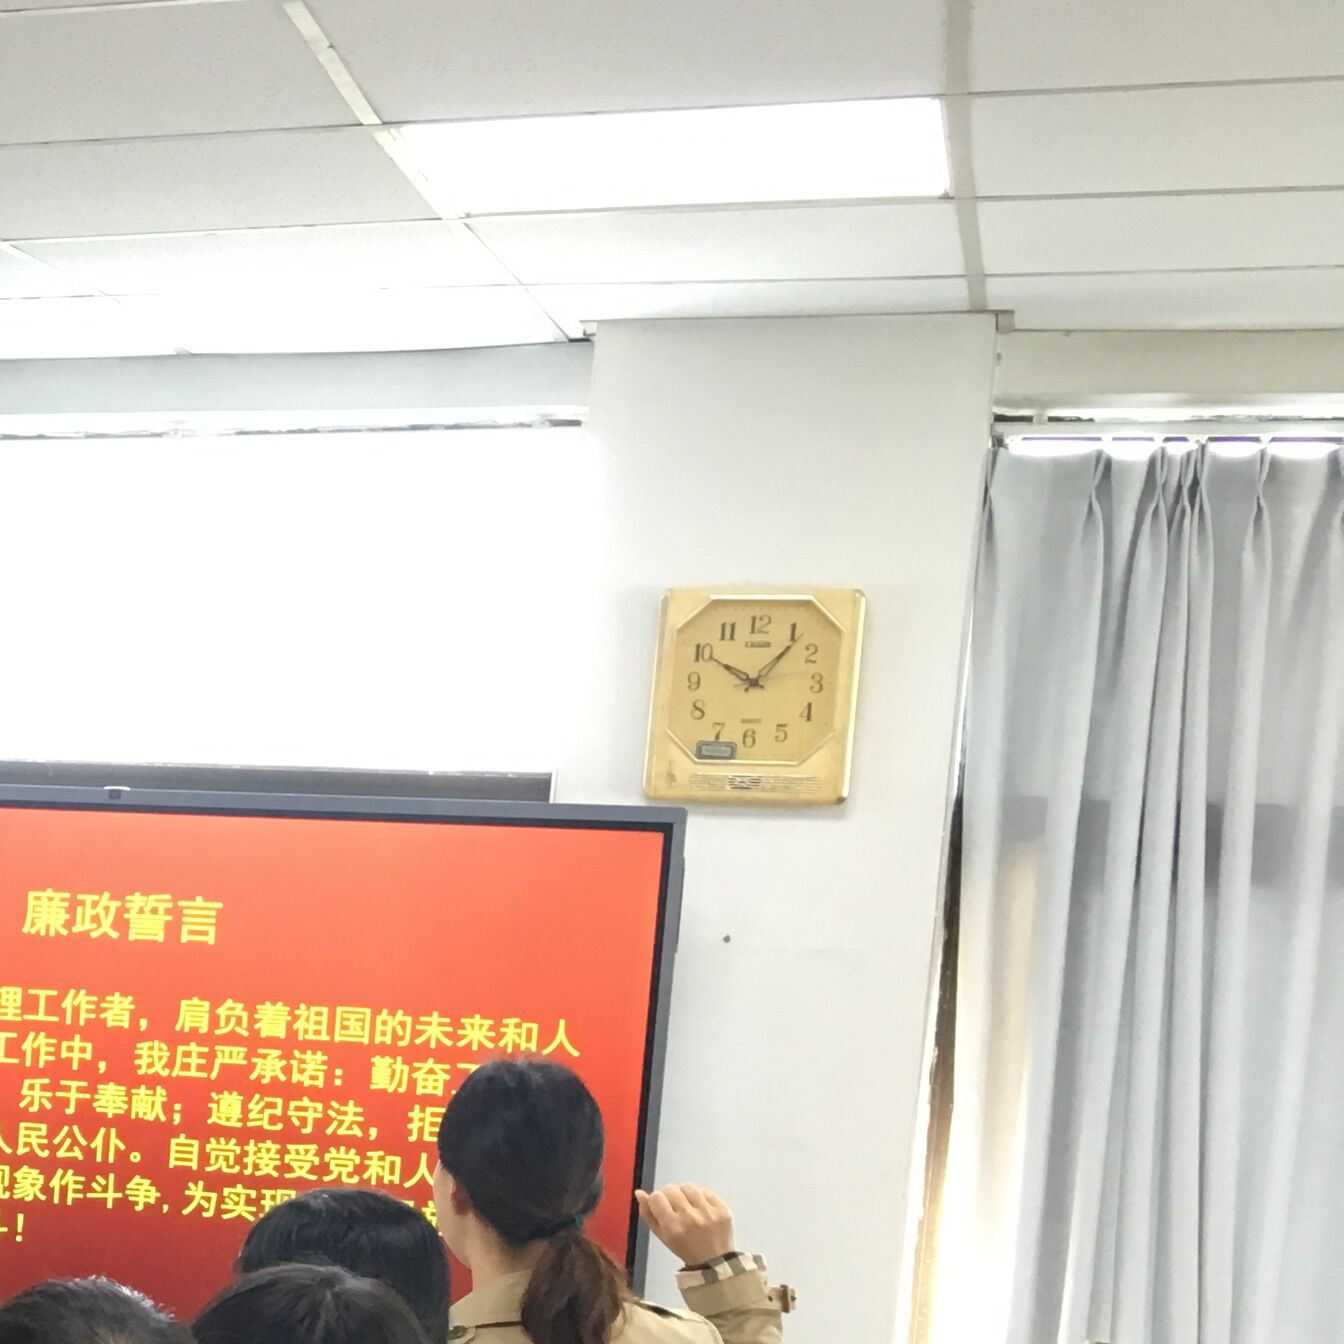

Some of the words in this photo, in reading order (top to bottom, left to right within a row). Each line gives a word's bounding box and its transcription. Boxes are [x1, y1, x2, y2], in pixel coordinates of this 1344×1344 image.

[719, 621, 736, 642] 11
[749, 615, 772, 635] 12
[789, 621, 798, 643] 1
[694, 643, 714, 663] 10
[804, 643, 819, 664] 2
[687, 671, 701, 692] 9
[809, 673, 824, 694] 3
[690, 699, 706, 720] 8
[800, 701, 813, 722] 4
[712, 721, 726, 741] 7
[742, 728, 757, 749] 6
[774, 723, 789, 743] 5
[21, 887, 224, 946] 廉政誓言
